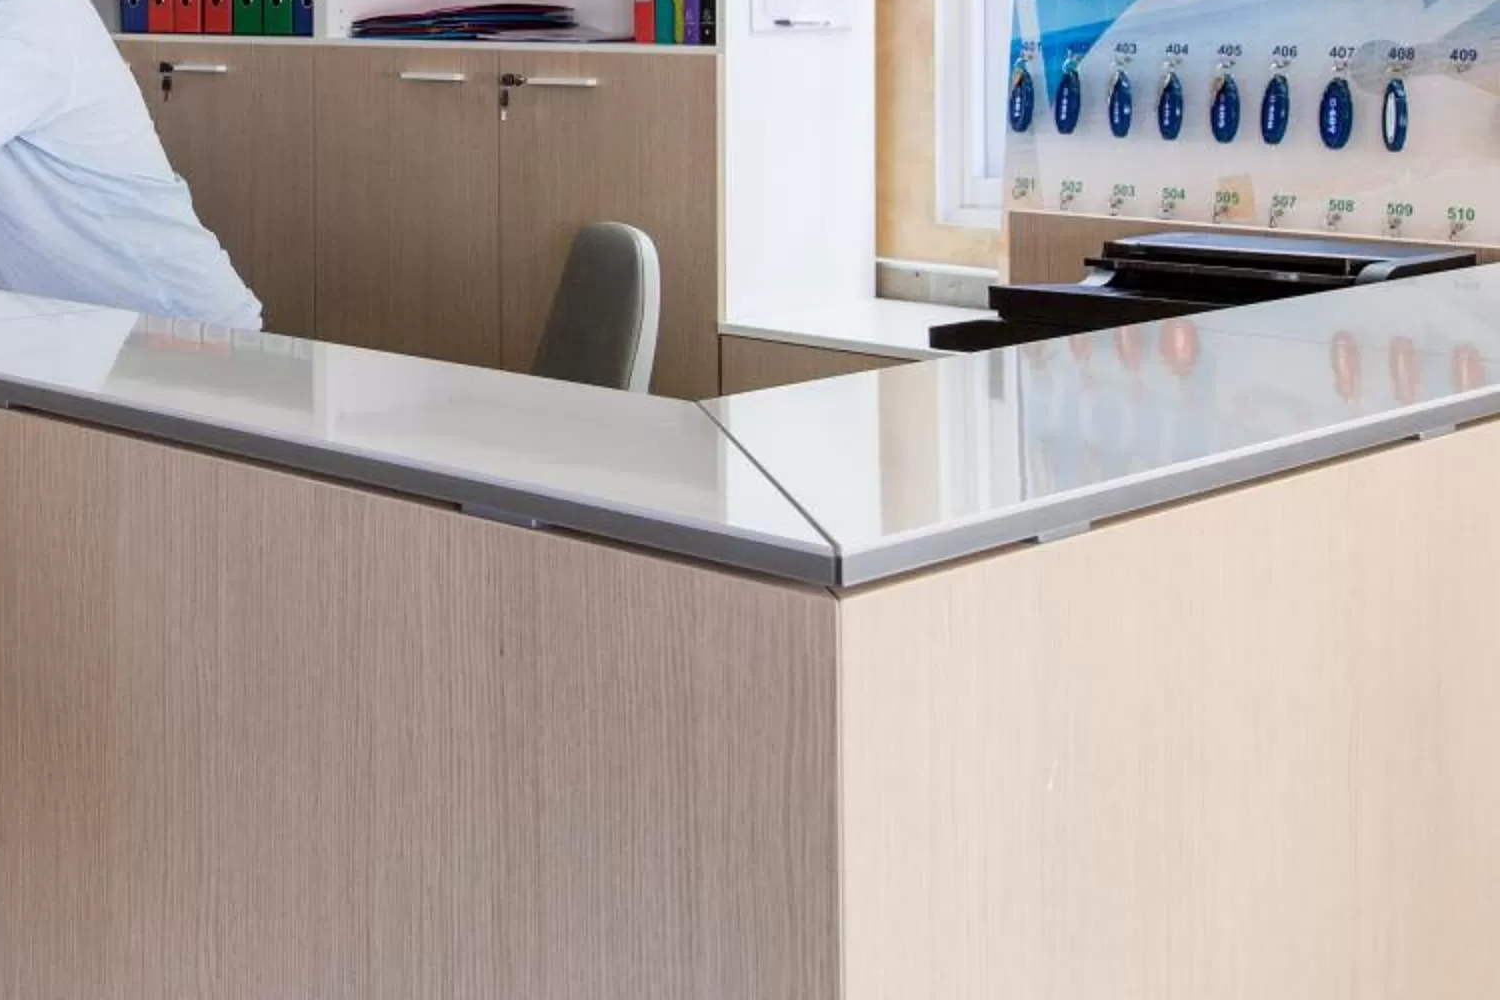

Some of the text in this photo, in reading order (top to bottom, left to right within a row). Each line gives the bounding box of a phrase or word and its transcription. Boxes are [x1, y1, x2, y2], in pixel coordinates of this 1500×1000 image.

[1165, 43, 1189, 55] 404
[1217, 43, 1242, 56] 405
[1272, 45, 1298, 57] 406
[1329, 46, 1355, 58] 407
[1388, 47, 1416, 60] 408
[1449, 48, 1478, 61] 409
[1328, 199, 1355, 213] 508
[1386, 203, 1414, 217] 509
[1447, 207, 1476, 221] 510
